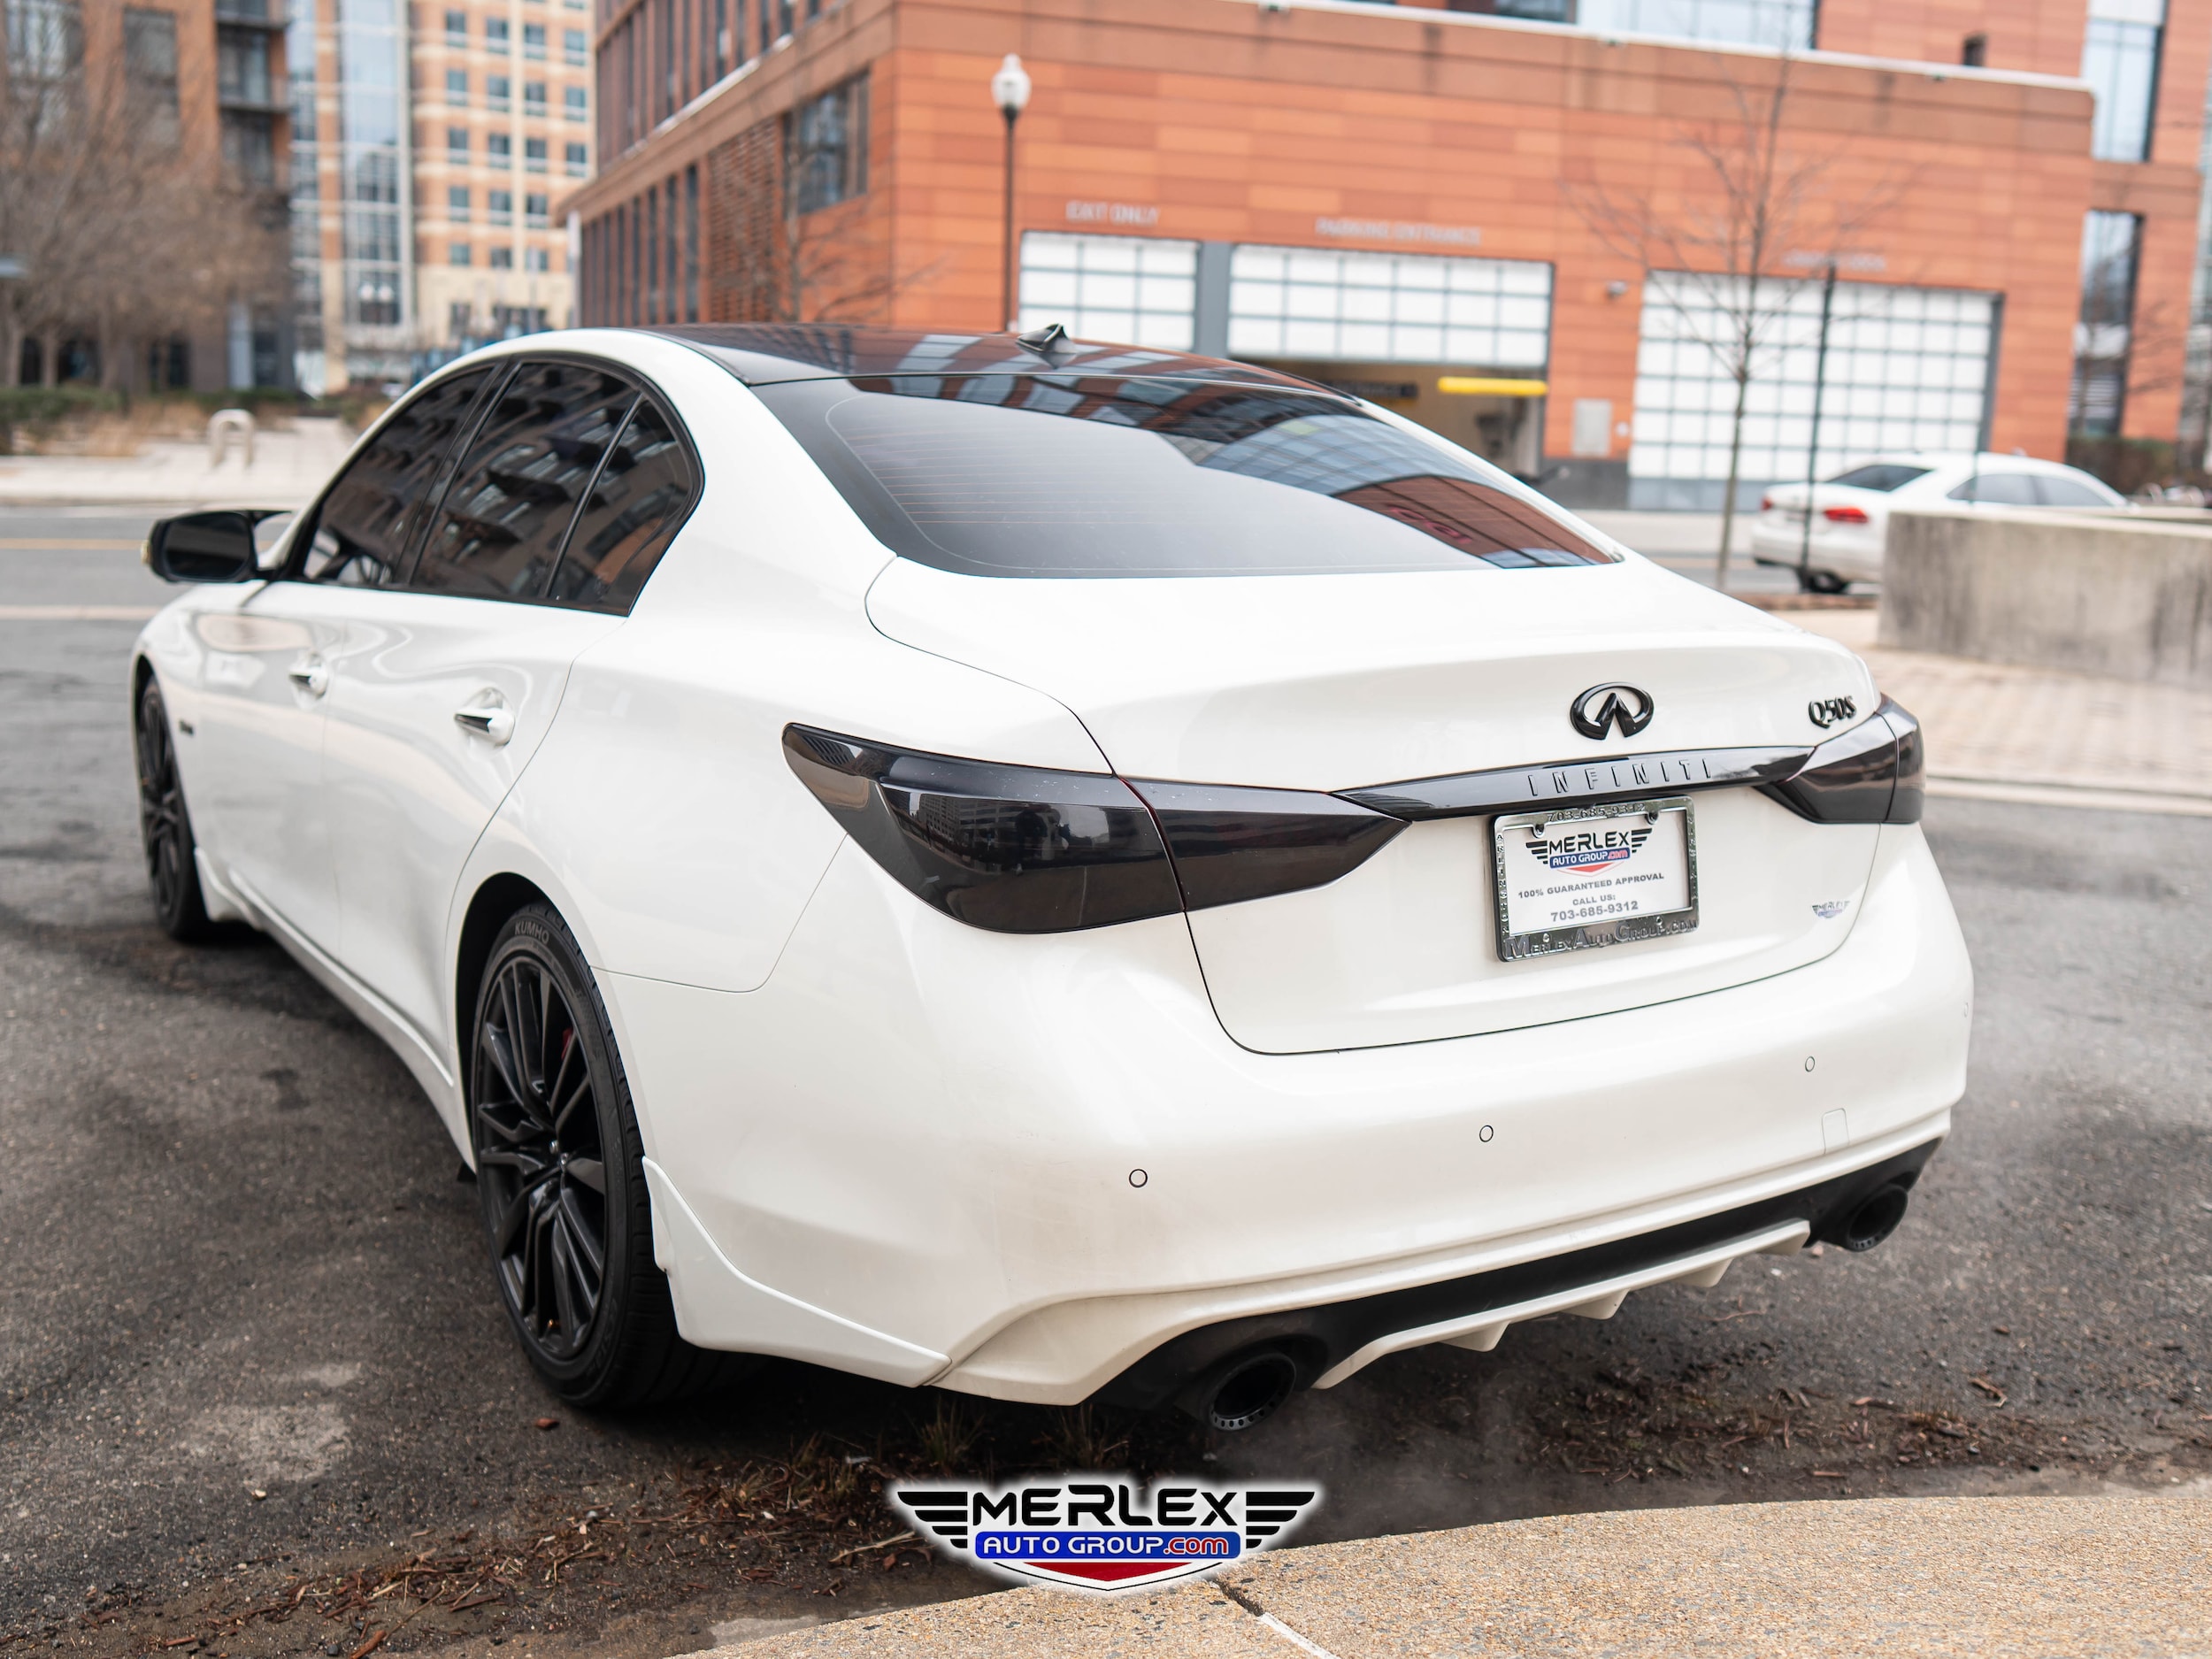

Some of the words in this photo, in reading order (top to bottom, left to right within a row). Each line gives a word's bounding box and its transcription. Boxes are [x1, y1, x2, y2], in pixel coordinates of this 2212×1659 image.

[1808, 695, 1857, 729] Q50S
[1528, 758, 1712, 796] INFINITI
[1548, 803, 1646, 822] 703-685-9312
[1549, 831, 1629, 855] MERLEX
[1552, 856, 1576, 866] AUTO
[1518, 888, 1544, 899] 100%
[1547, 879, 1612, 895] GUARANTEED
[1615, 872, 1664, 886] APPROVAL
[1551, 900, 1639, 922] 703-685-9312
[1572, 896, 1597, 906] CALL
[1600, 894, 1617, 902] US:
[515, 922, 549, 943] KUMHO
